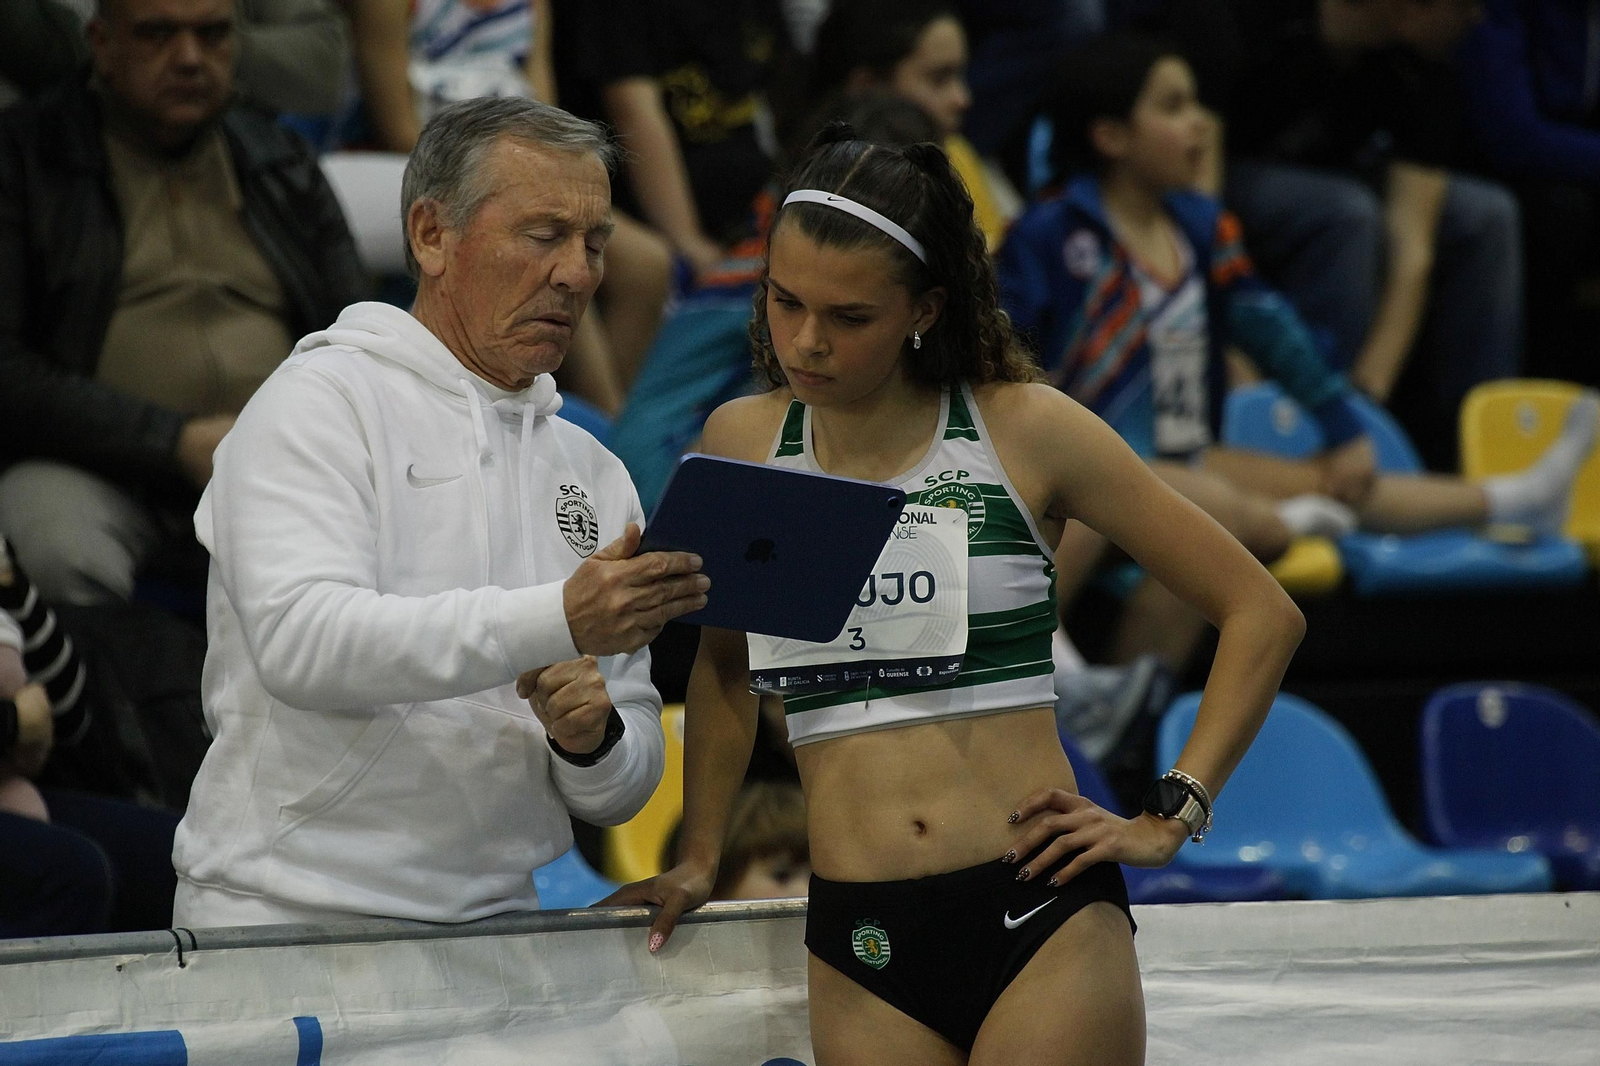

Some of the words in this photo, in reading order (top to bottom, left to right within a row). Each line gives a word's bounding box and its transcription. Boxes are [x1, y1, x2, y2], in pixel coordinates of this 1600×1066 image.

[924, 470, 970, 487] SCP
[924, 485, 976, 505] SPORTING
[561, 500, 595, 520] SPORTING
[567, 535, 596, 551] PORTUGAL
[847, 627, 866, 651] 3
[855, 929, 885, 941] SPORTING
